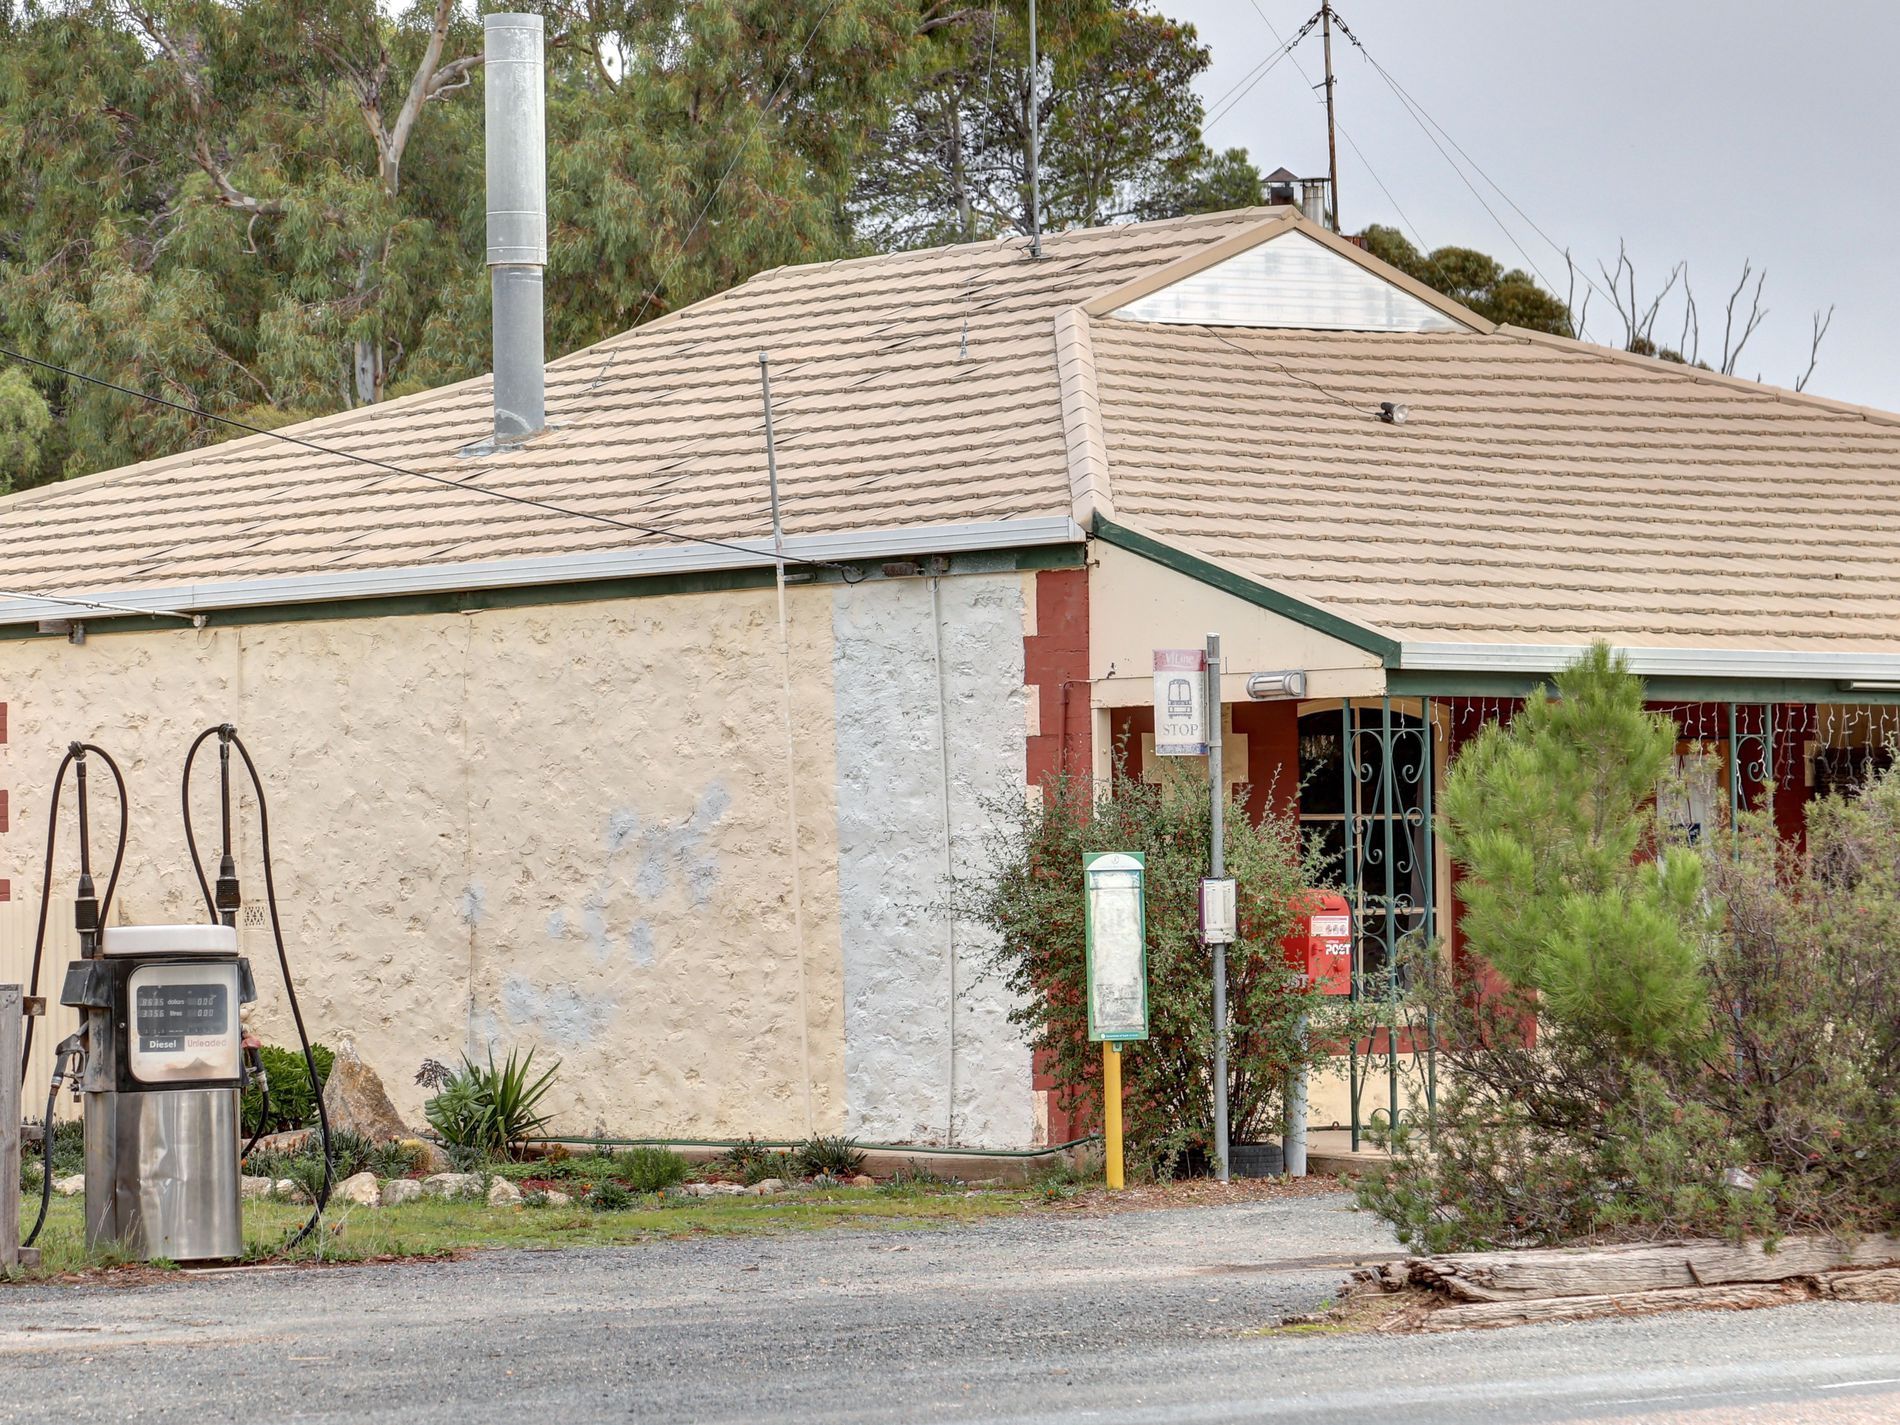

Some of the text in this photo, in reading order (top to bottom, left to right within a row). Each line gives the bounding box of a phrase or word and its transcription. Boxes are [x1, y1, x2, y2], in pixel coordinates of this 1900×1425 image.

[1162, 724, 1198, 737] STOP
[1325, 943, 1351, 955] POST
[149, 1040, 177, 1049] Diesel
[187, 1039, 227, 1048] Unleaded
